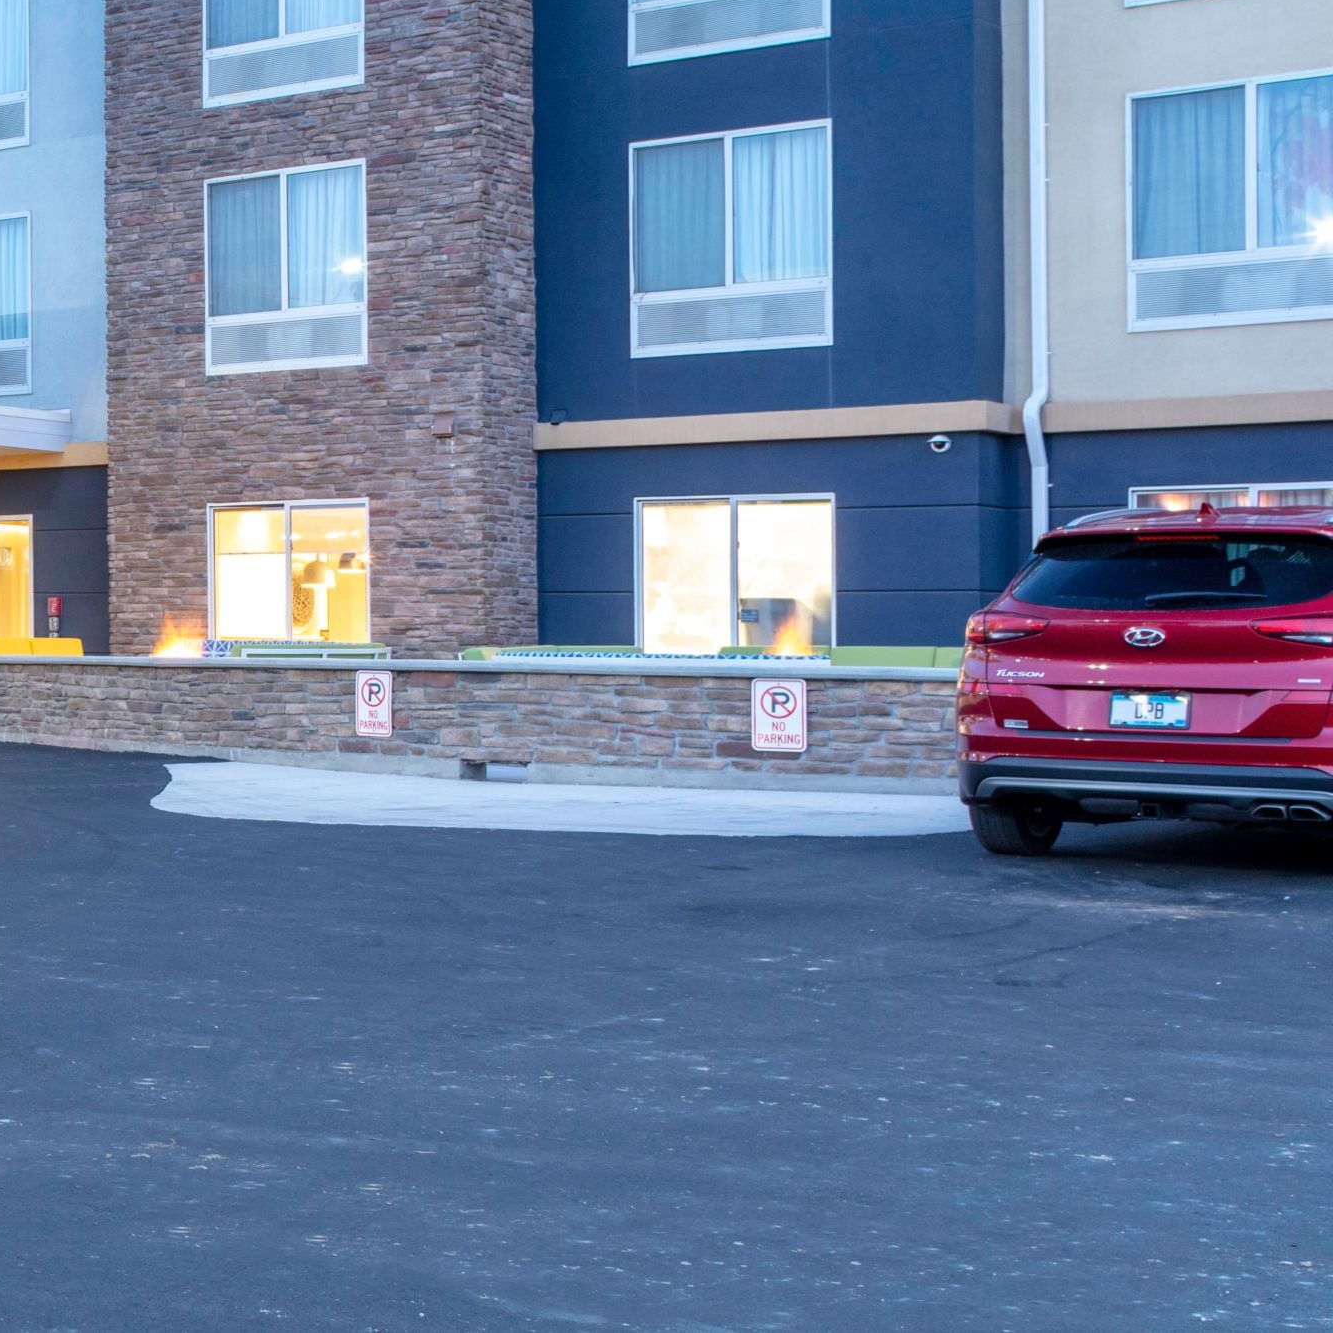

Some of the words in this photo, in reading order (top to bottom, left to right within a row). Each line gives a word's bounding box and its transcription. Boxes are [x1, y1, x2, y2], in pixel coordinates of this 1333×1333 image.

[369, 710, 378, 719] NO
[359, 720, 388, 730] PARKING
[772, 722, 786, 732] NO
[758, 733, 801, 745] PARKING
